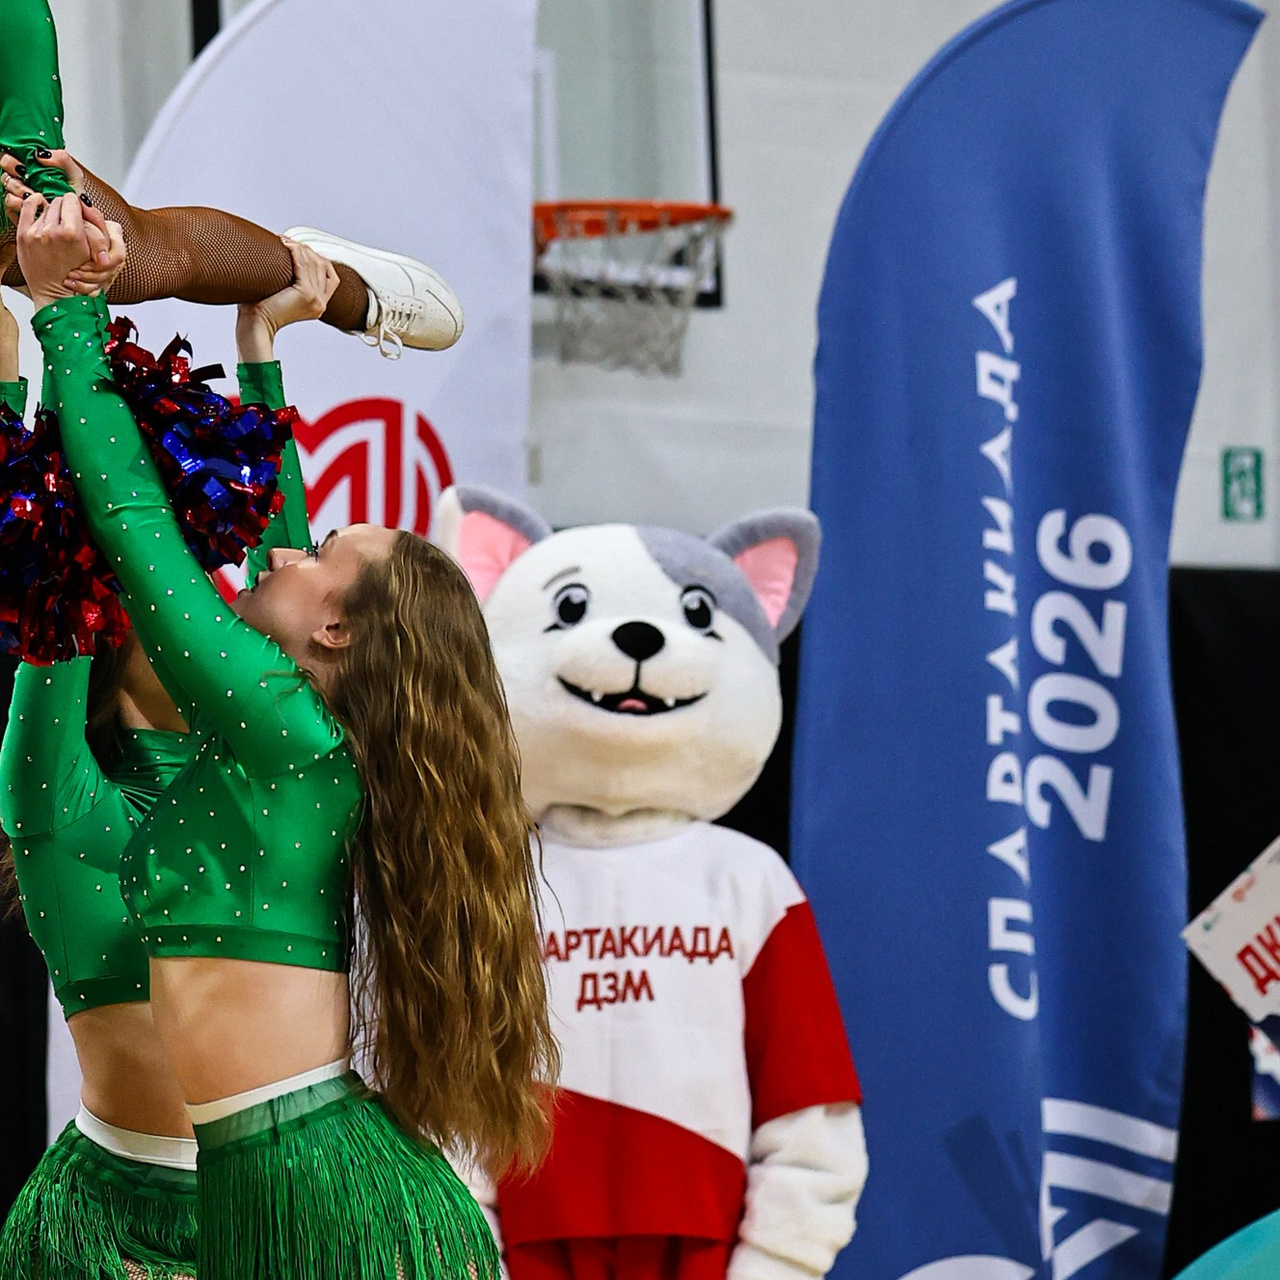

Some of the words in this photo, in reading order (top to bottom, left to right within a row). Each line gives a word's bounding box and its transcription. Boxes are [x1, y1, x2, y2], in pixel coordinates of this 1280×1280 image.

[1023, 507, 1133, 842] 2026
[538, 925, 735, 966] АРТАКИАДА
[1235, 914, 1280, 996] ДК
[576, 969, 655, 1013] ДЗМ
